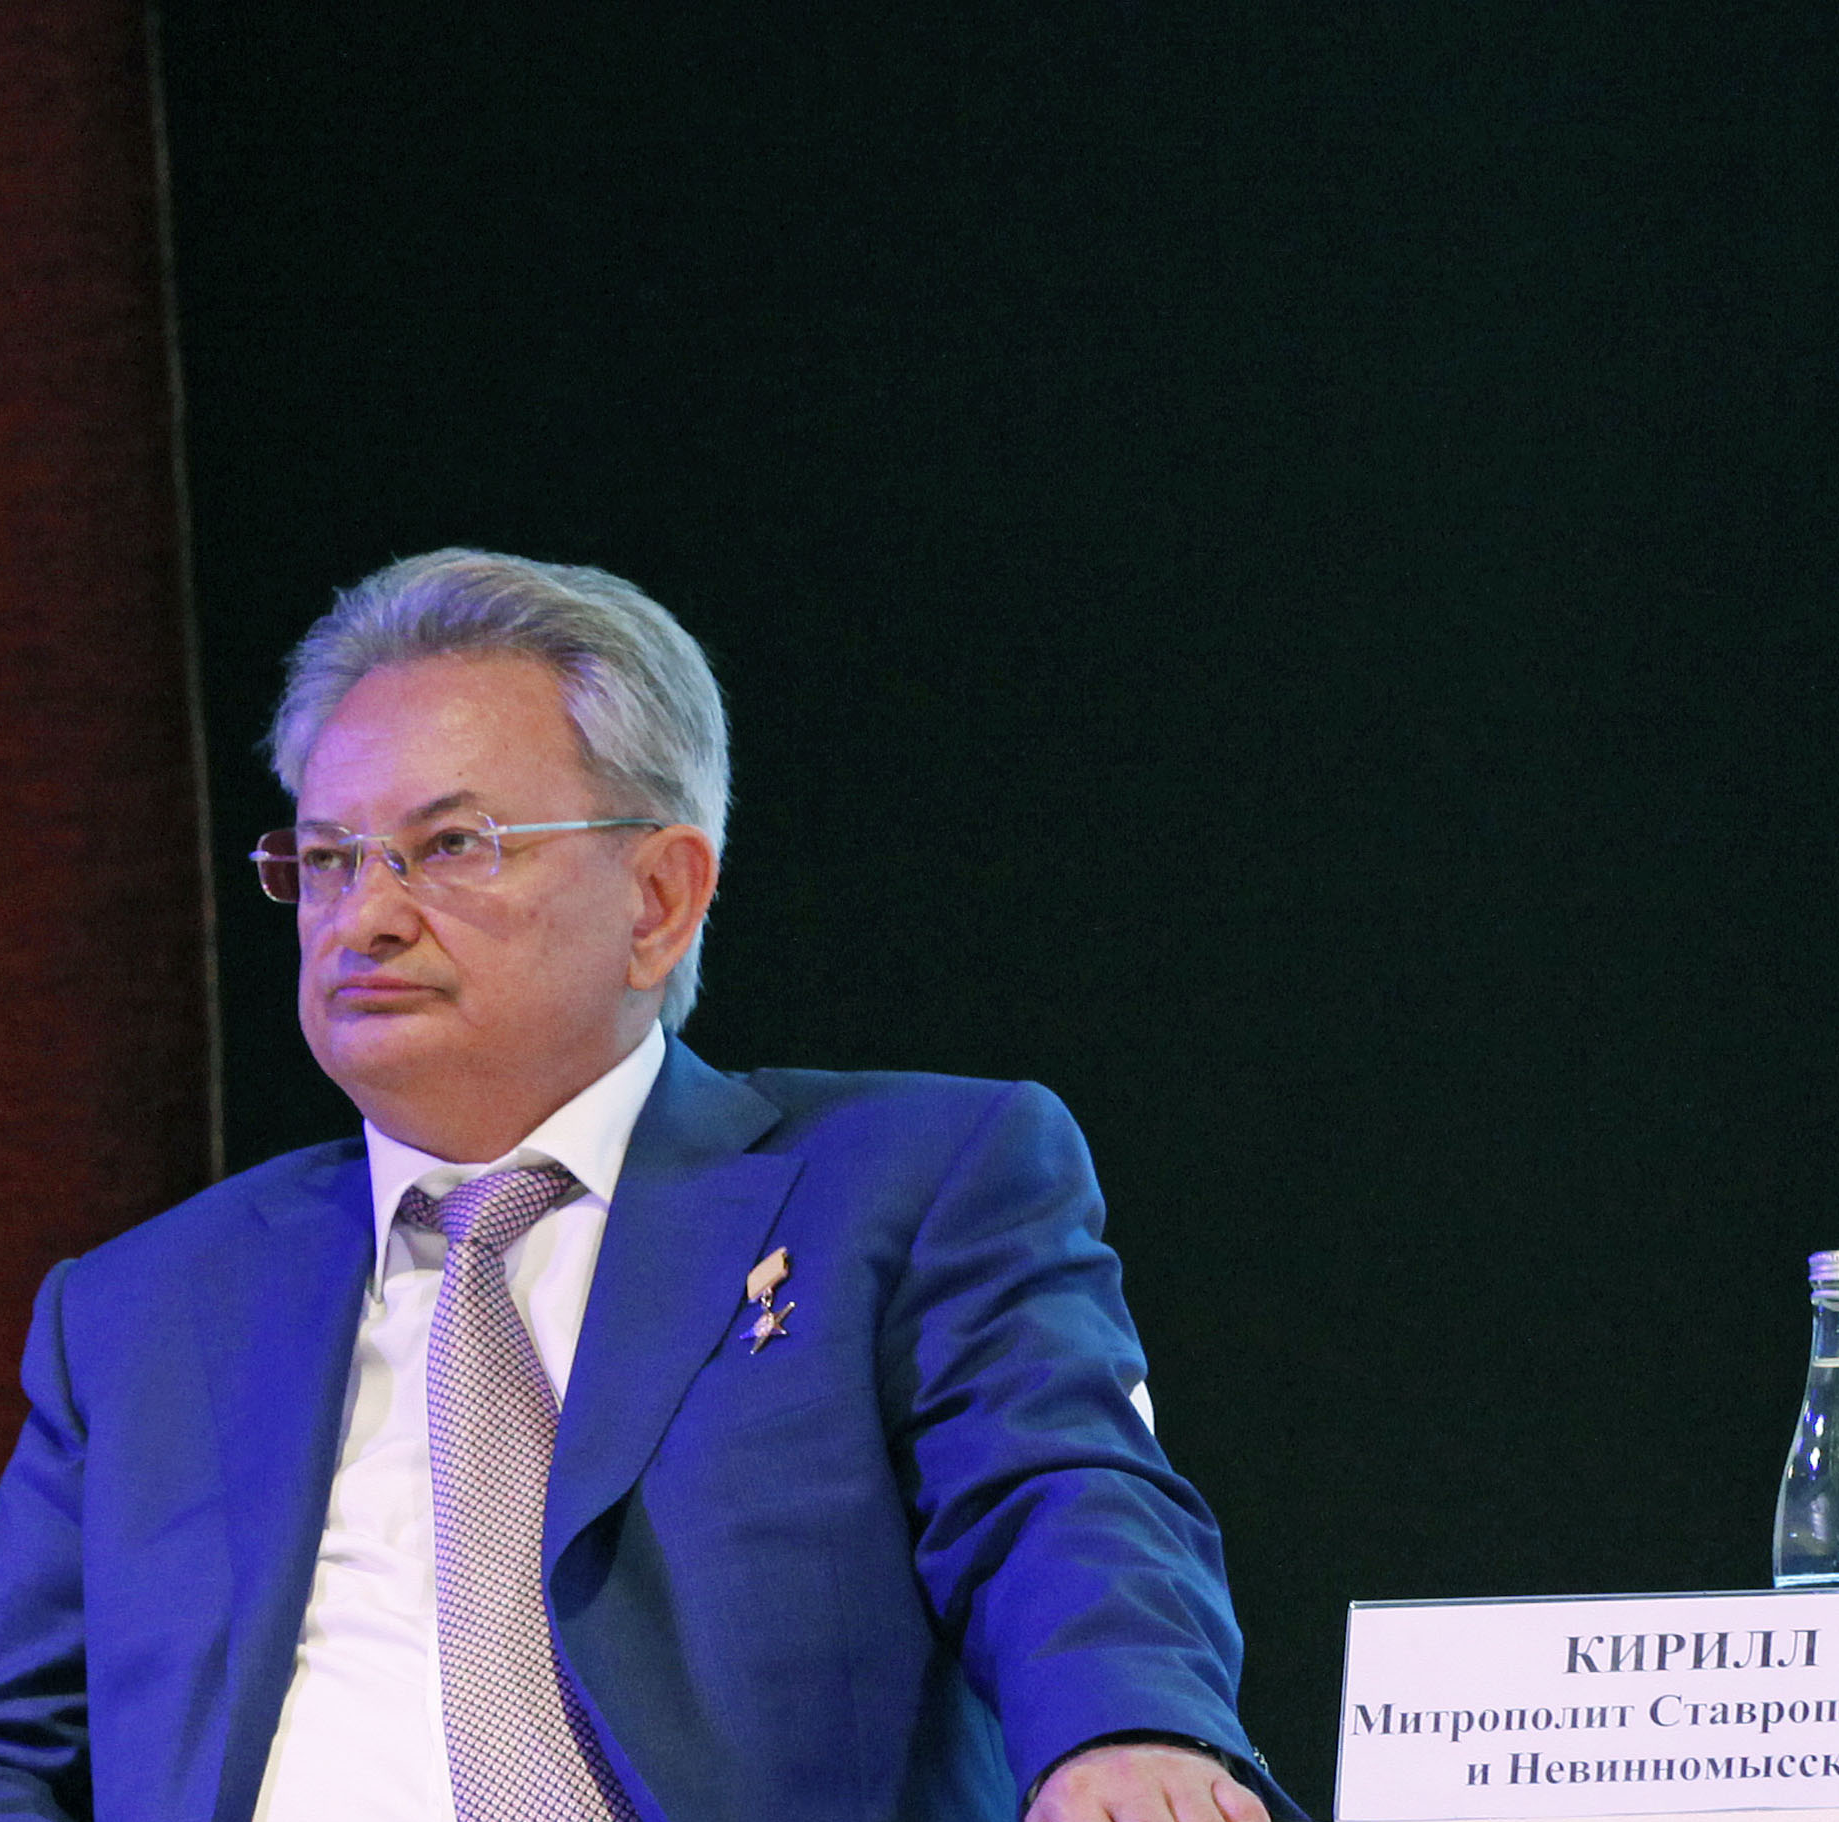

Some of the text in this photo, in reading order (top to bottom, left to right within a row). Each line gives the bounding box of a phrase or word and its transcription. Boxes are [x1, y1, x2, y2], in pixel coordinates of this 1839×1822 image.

[1563, 1629, 1820, 1674] КИРИЛЛ
[1352, 1694, 1839, 1742] Митрополит Ставроп
[1466, 1763, 1490, 1786] и
